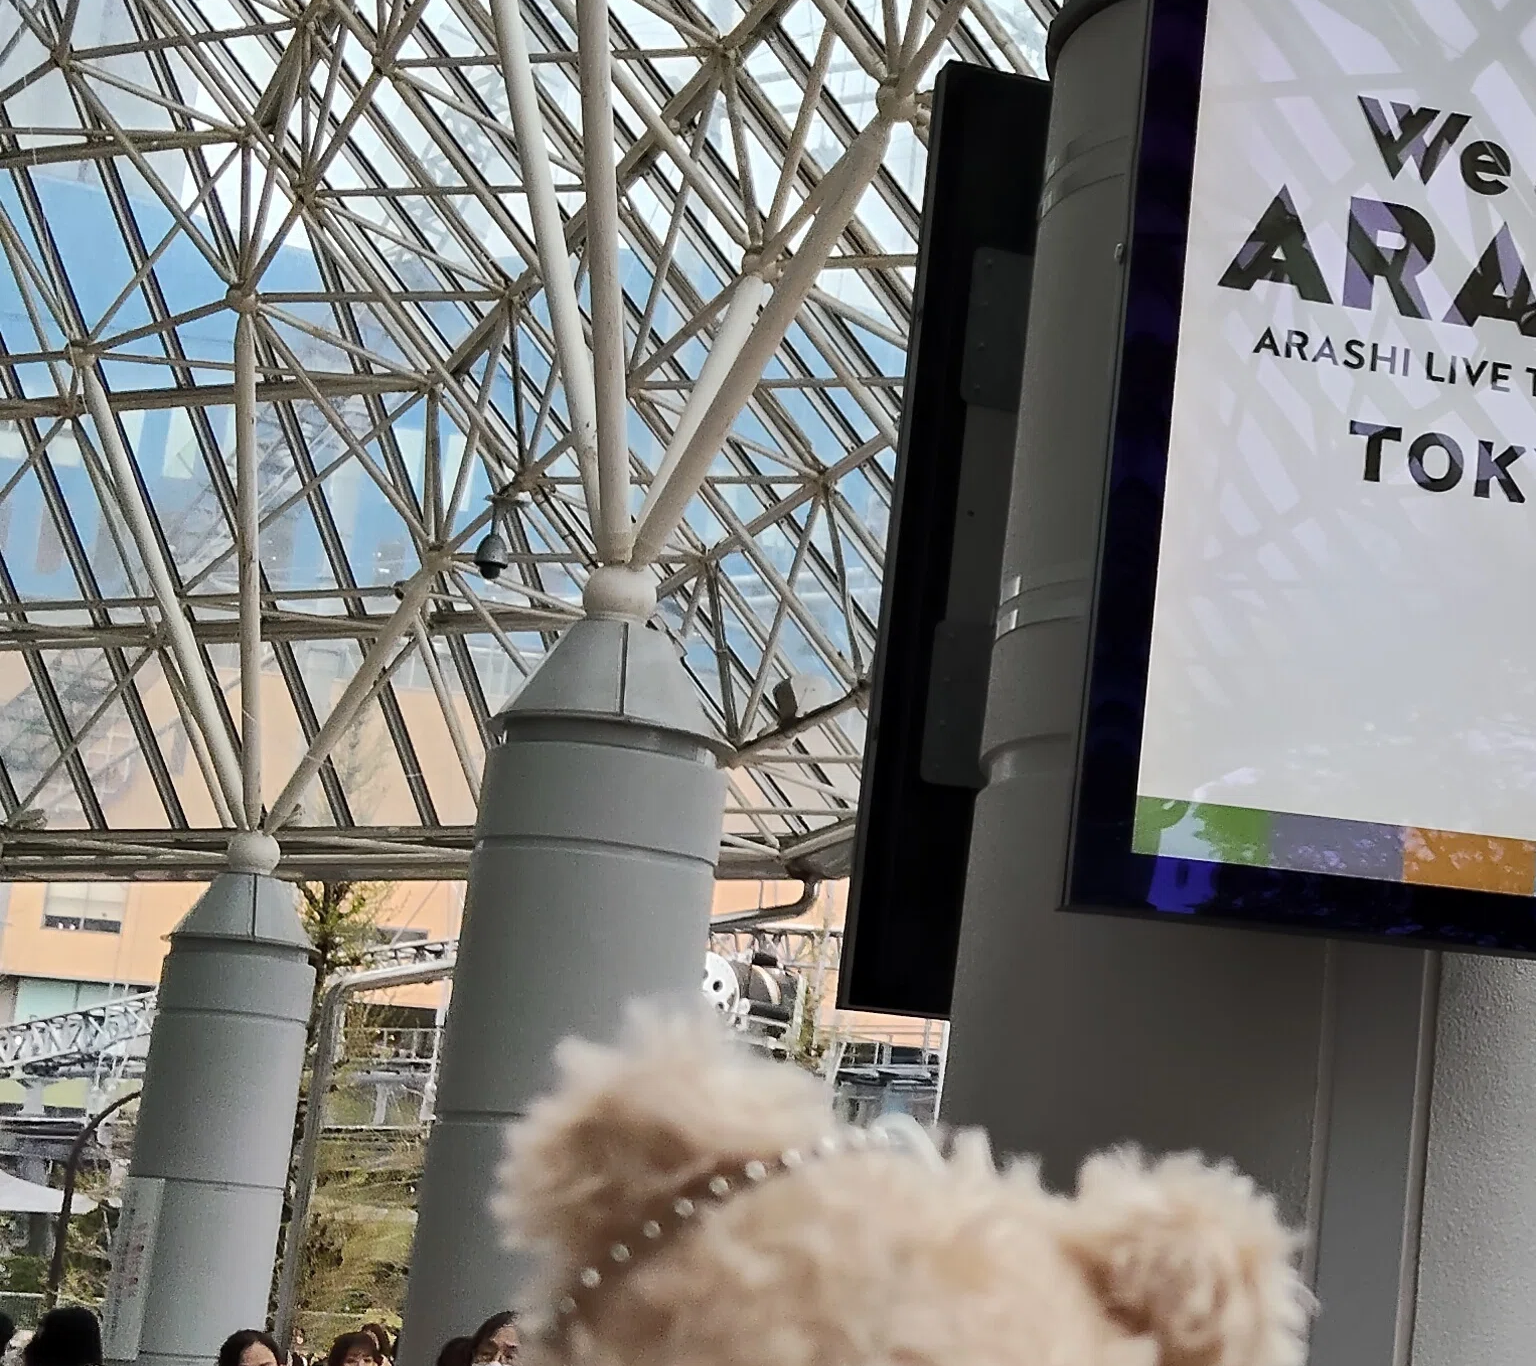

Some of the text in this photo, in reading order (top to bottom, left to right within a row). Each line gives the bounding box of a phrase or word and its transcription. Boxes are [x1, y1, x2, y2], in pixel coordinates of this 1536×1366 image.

[1358, 95, 1511, 196] We
[1253, 326, 1410, 378] ARASHI
[1425, 351, 1511, 393] LIVE
